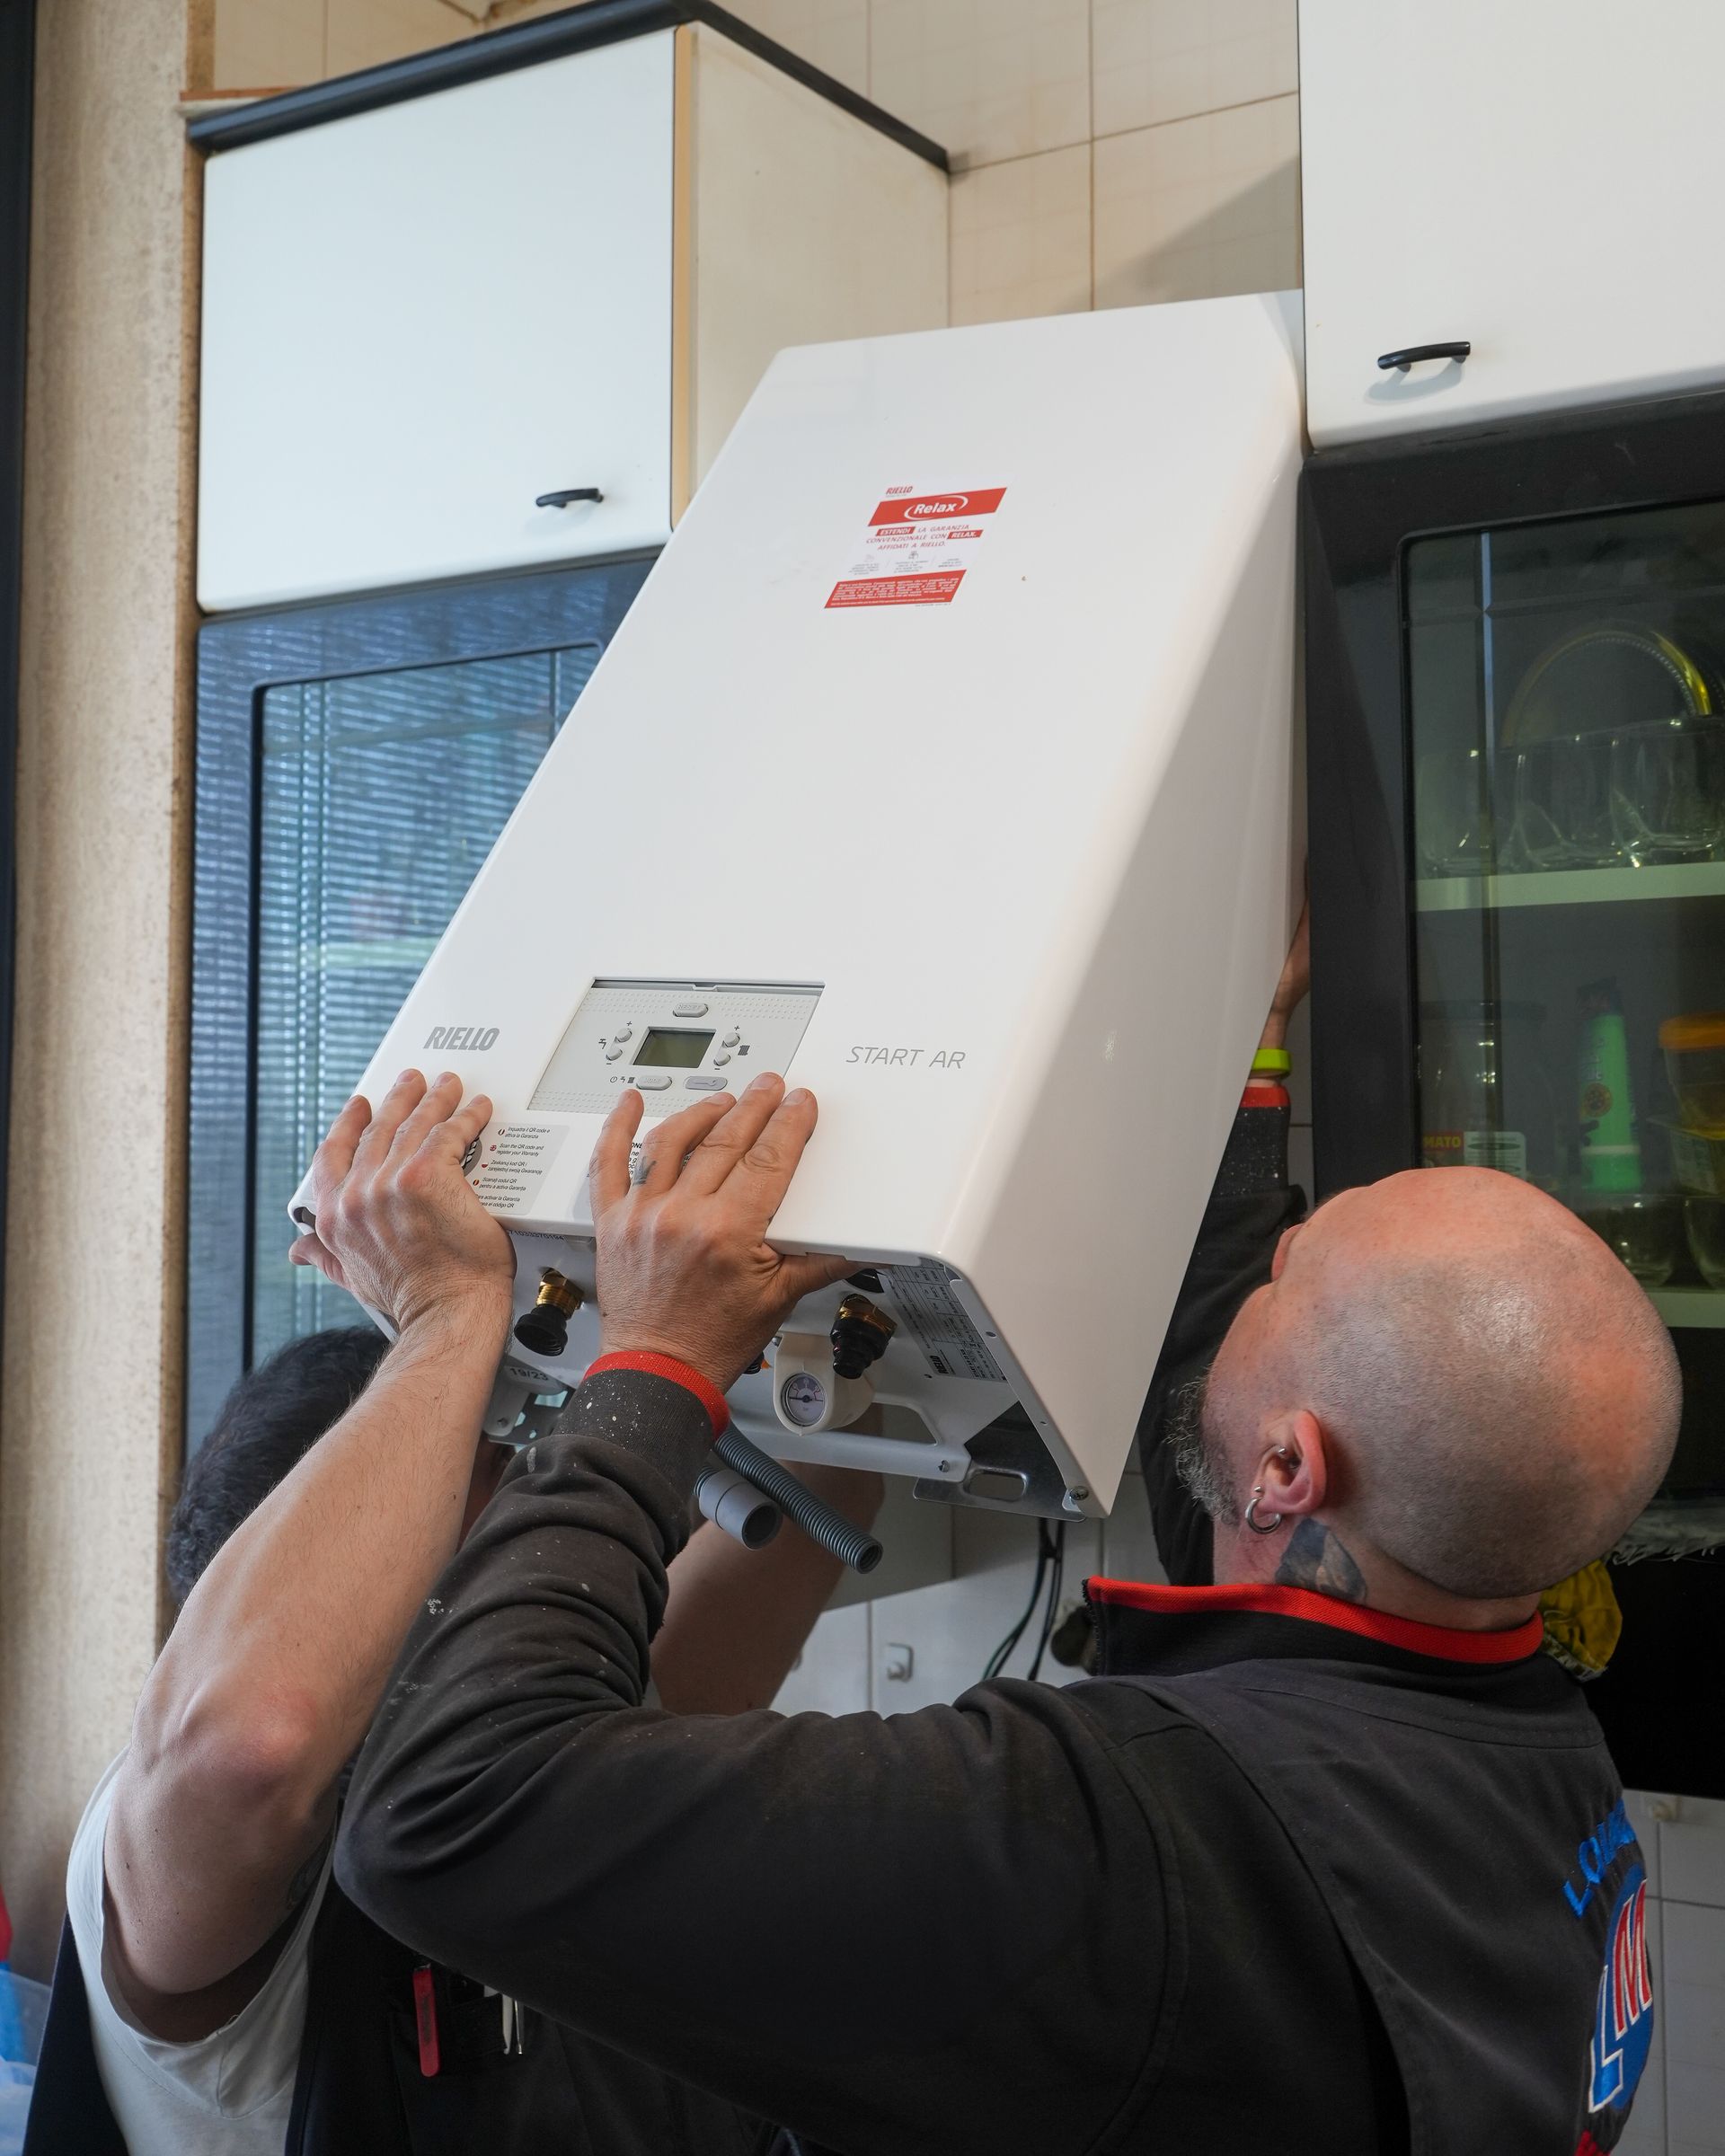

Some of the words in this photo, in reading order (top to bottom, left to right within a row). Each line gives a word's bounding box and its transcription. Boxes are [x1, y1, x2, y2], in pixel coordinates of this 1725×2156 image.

[886, 486, 913, 494] RIELLO
[914, 501, 957, 515] Relax
[866, 535, 926, 543] CONVENZIONALE
[423, 1027, 500, 1051] RIELLO
[845, 1046, 924, 1065] START
[929, 1050, 966, 1069] AR
[509, 1367, 548, 1381] 19/23
